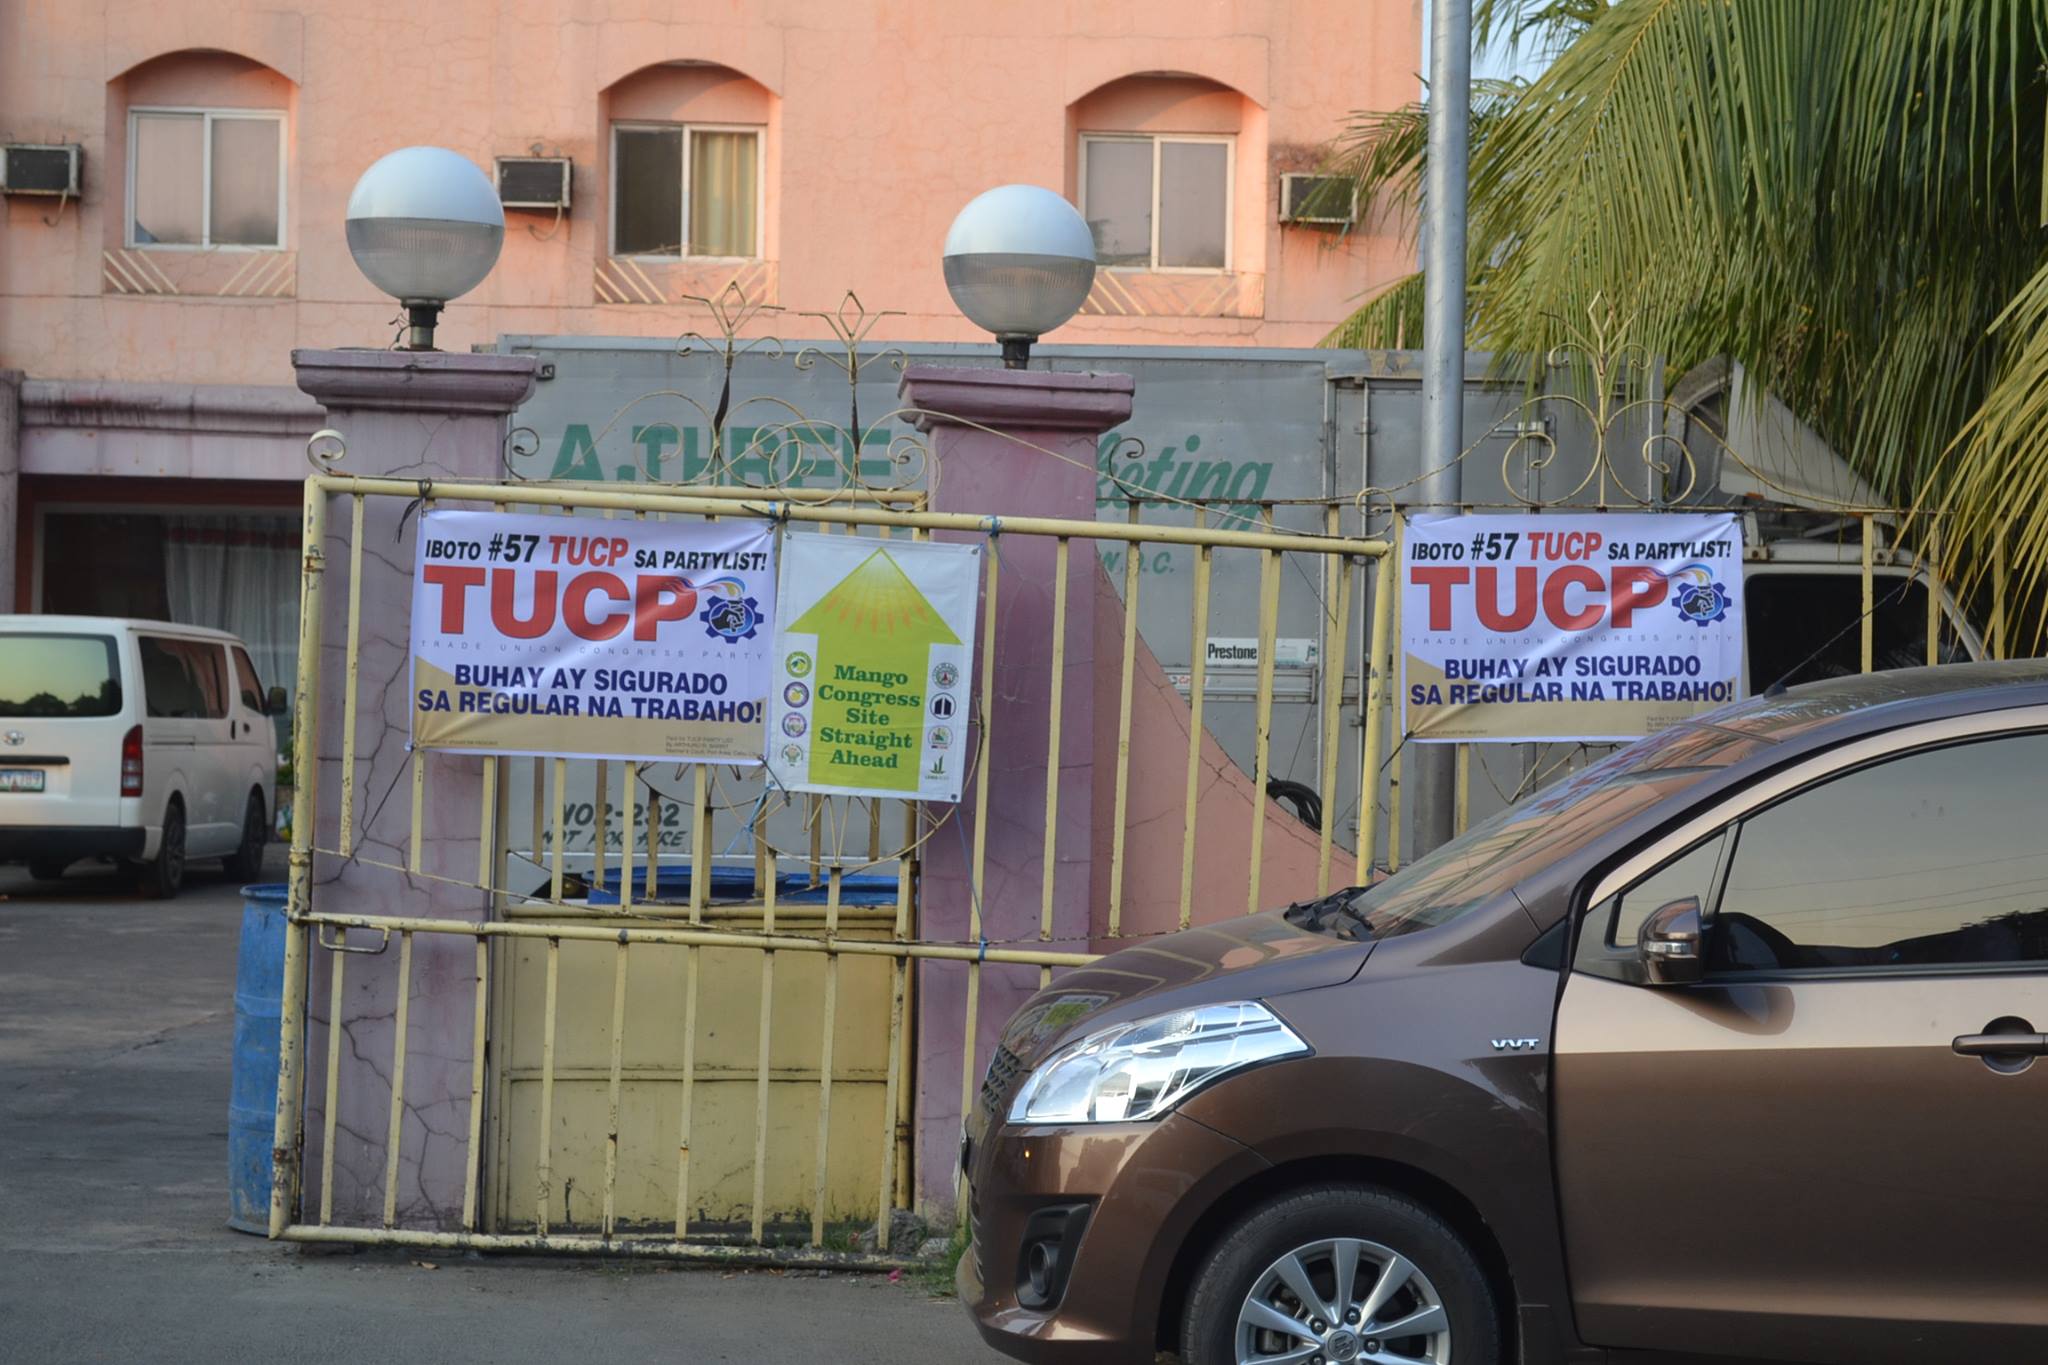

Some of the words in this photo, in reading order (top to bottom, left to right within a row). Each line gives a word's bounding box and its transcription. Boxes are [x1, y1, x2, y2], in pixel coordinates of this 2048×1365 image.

[425, 539, 481, 560] IBOTO
[488, 533, 541, 562] #57
[548, 535, 629, 567] TUCP
[634, 549, 657, 569] SA
[662, 550, 767, 571] PARTYLIST!
[1411, 543, 1465, 560] IBOTO
[1471, 532, 1519, 561] #57
[1527, 532, 1603, 561] TUCP
[1608, 542, 1630, 560] SA
[1634, 540, 1732, 560] PARTYLIST!
[423, 564, 698, 642] TUCP
[1410, 565, 1669, 632] TUCP
[421, 640, 481, 649] TRADE
[500, 644, 561, 653] UNION
[579, 646, 684, 657] CONGRESS
[702, 651, 762, 660] PARTY
[1207, 643, 1257, 660] Prestone
[1411, 637, 1470, 645] TRADE
[1561, 634, 1659, 644] CONGRESS
[454, 664, 545, 688] BUHAY
[551, 668, 586, 689] AY
[594, 669, 728, 695] SIGURADO
[833, 664, 909, 688] Mango
[1444, 658, 1528, 680] BUHAY
[1535, 656, 1568, 677] AY
[1575, 655, 1701, 677] SIGURADO
[818, 684, 920, 708] Congress
[1411, 684, 1442, 706] SA
[1450, 681, 1563, 705] REGULAR
[1571, 681, 1605, 701] NA
[1612, 681, 1733, 703] TRABAHO!
[418, 690, 451, 712] SA
[459, 691, 580, 717] REGULAR
[588, 697, 624, 718] NA
[631, 698, 762, 723] TRABAHO!
[846, 708, 889, 726] Site
[820, 727, 912, 751] Straight
[829, 749, 898, 769] Ahead
[1491, 1038, 1539, 1049] VVT
